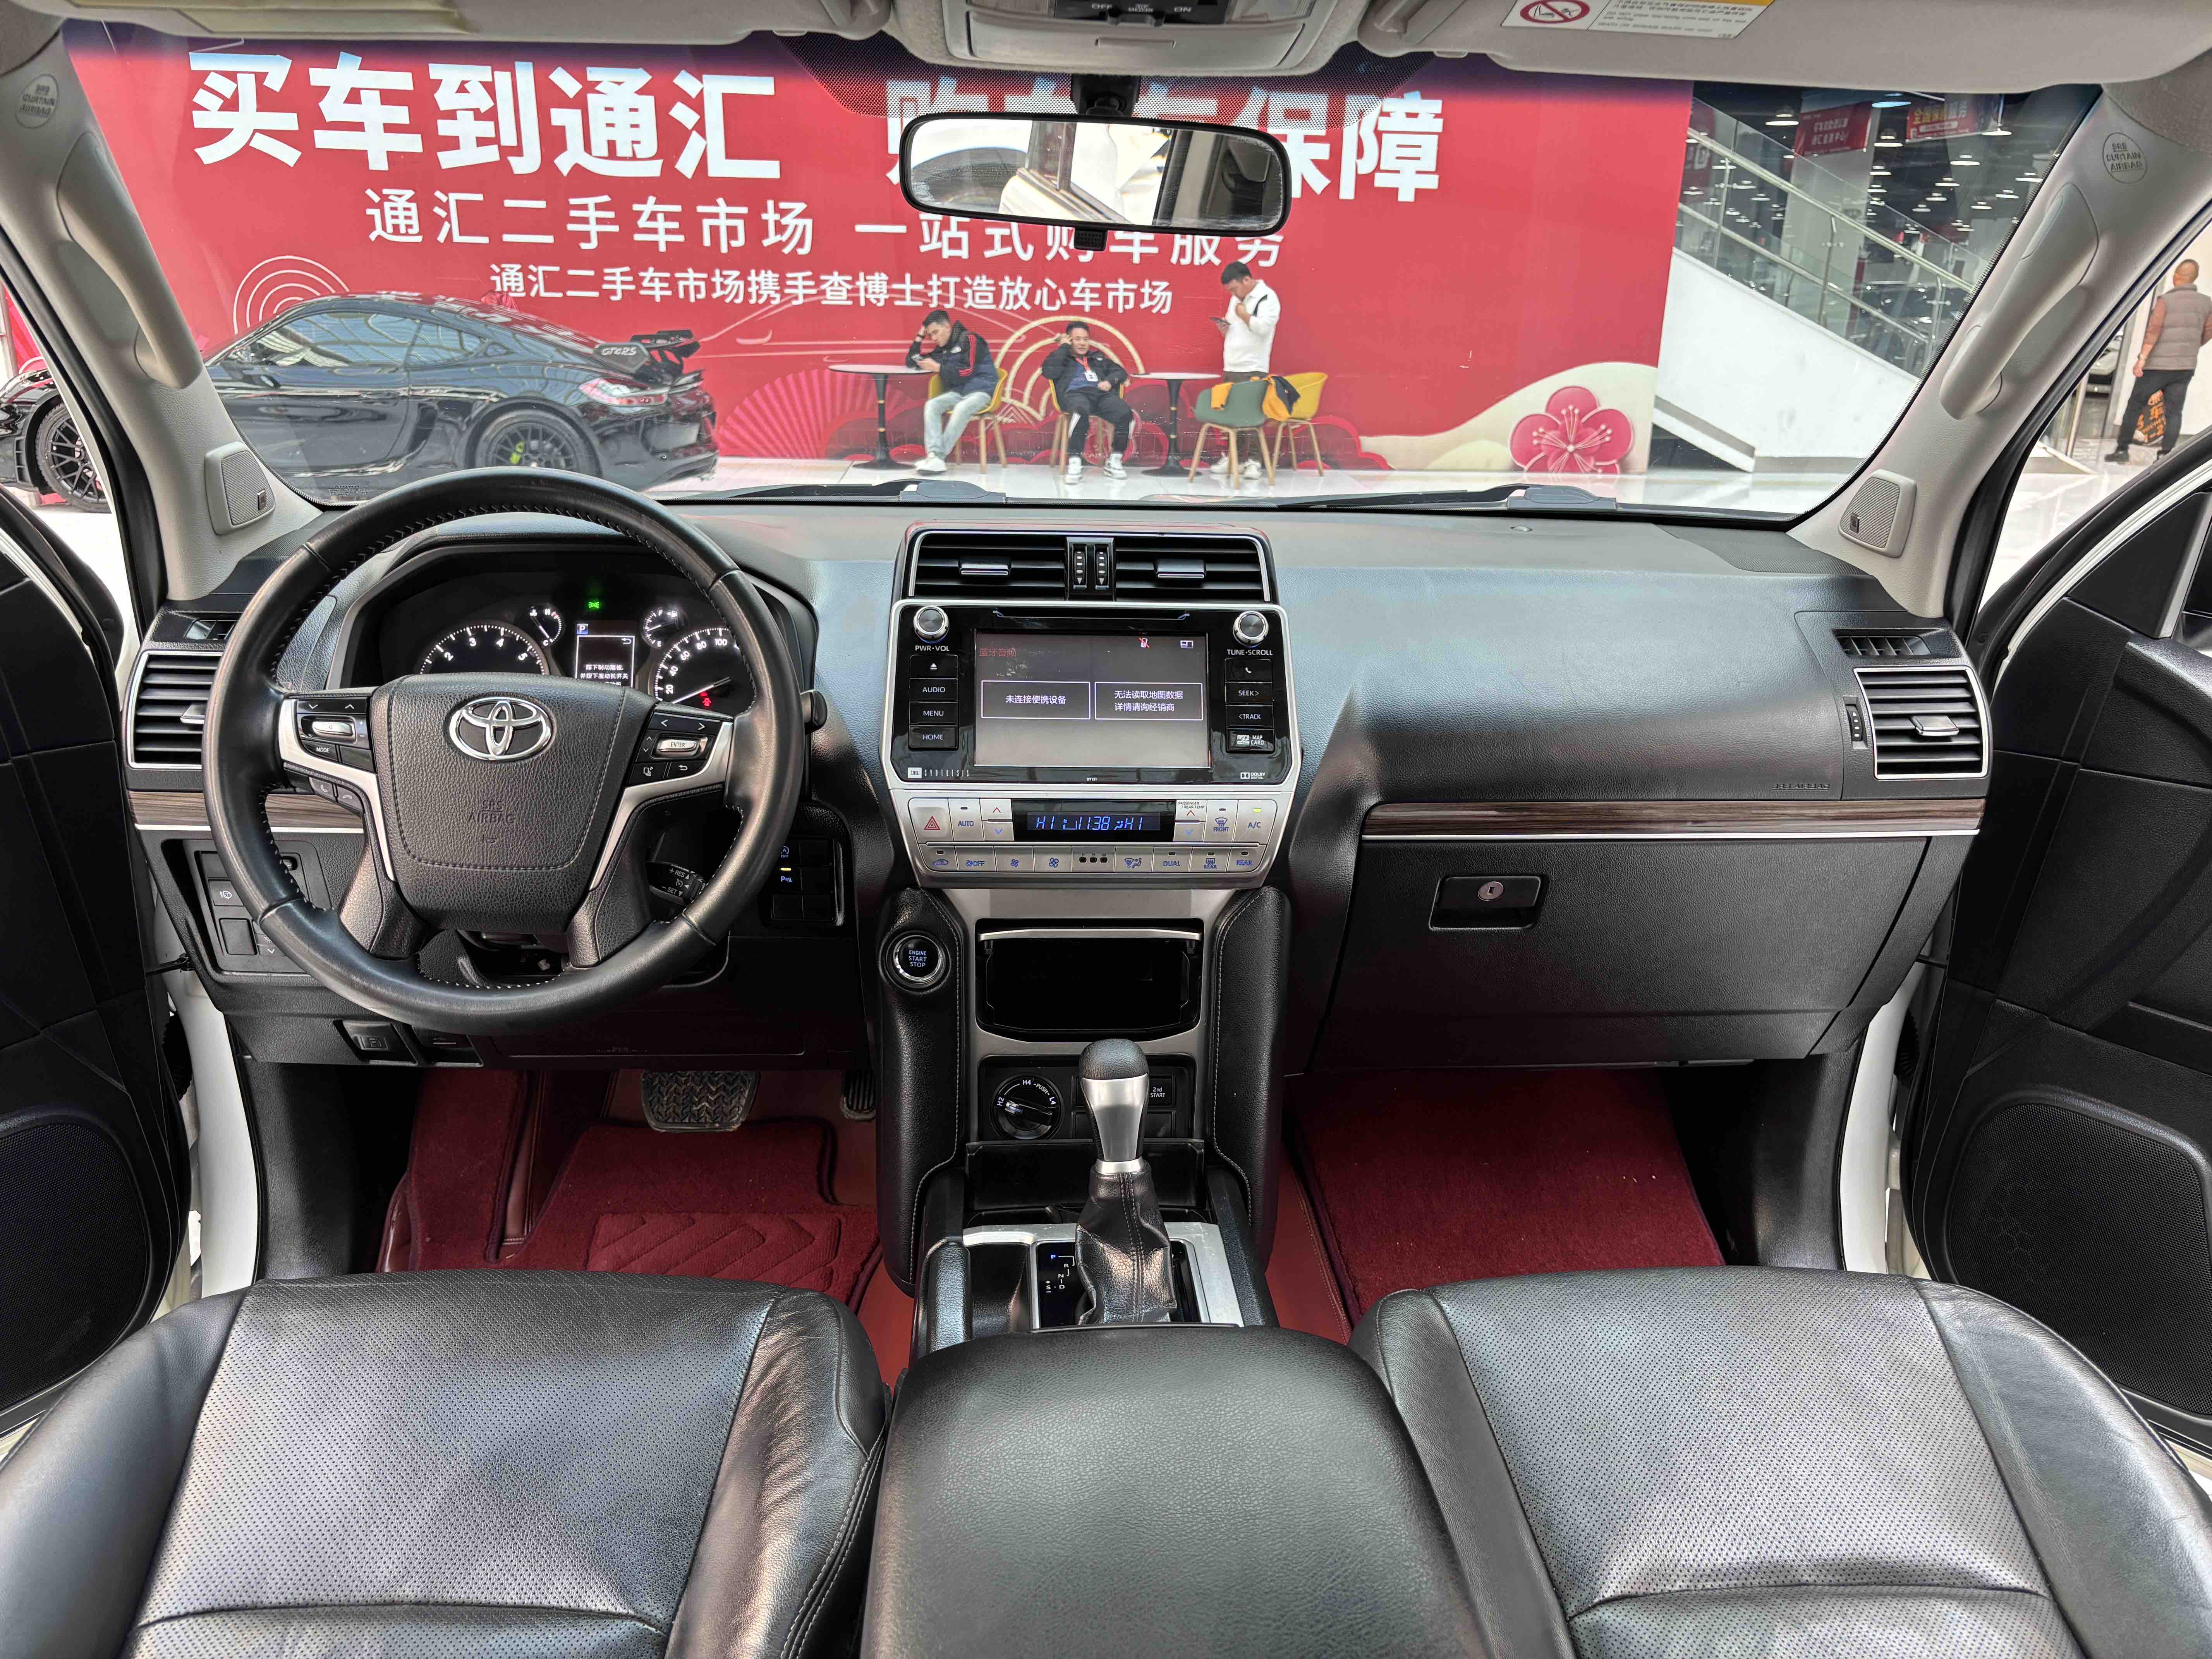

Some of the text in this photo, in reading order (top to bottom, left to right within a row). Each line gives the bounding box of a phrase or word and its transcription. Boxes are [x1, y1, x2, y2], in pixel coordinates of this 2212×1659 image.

[189, 52, 780, 179] 买车到通汇
[365, 188, 814, 254] 通汇二手车市场
[490, 263, 1172, 314] 通汇二手车市场携手查博士打造放心车市场
[469, 638, 477, 646] 3
[496, 638, 504, 647] 4
[697, 641, 707, 650] 80
[444, 652, 453, 661] 2
[518, 653, 528, 661] 5
[680, 651, 690, 660] 60
[979, 648, 1017, 657] 蓝牙音频
[669, 666, 678, 676] 40
[666, 684, 674, 694] 20
[1114, 690, 1183, 699] 无法读取地图数据
[1006, 695, 1066, 704] 未连接便携设备
[1115, 702, 1175, 712] 详情请询经销商
[483, 799, 503, 810] SRS
[469, 812, 515, 824] AIRBAG
[996, 1097, 1005, 1106] H2
[1049, 1096, 1056, 1105] L4
